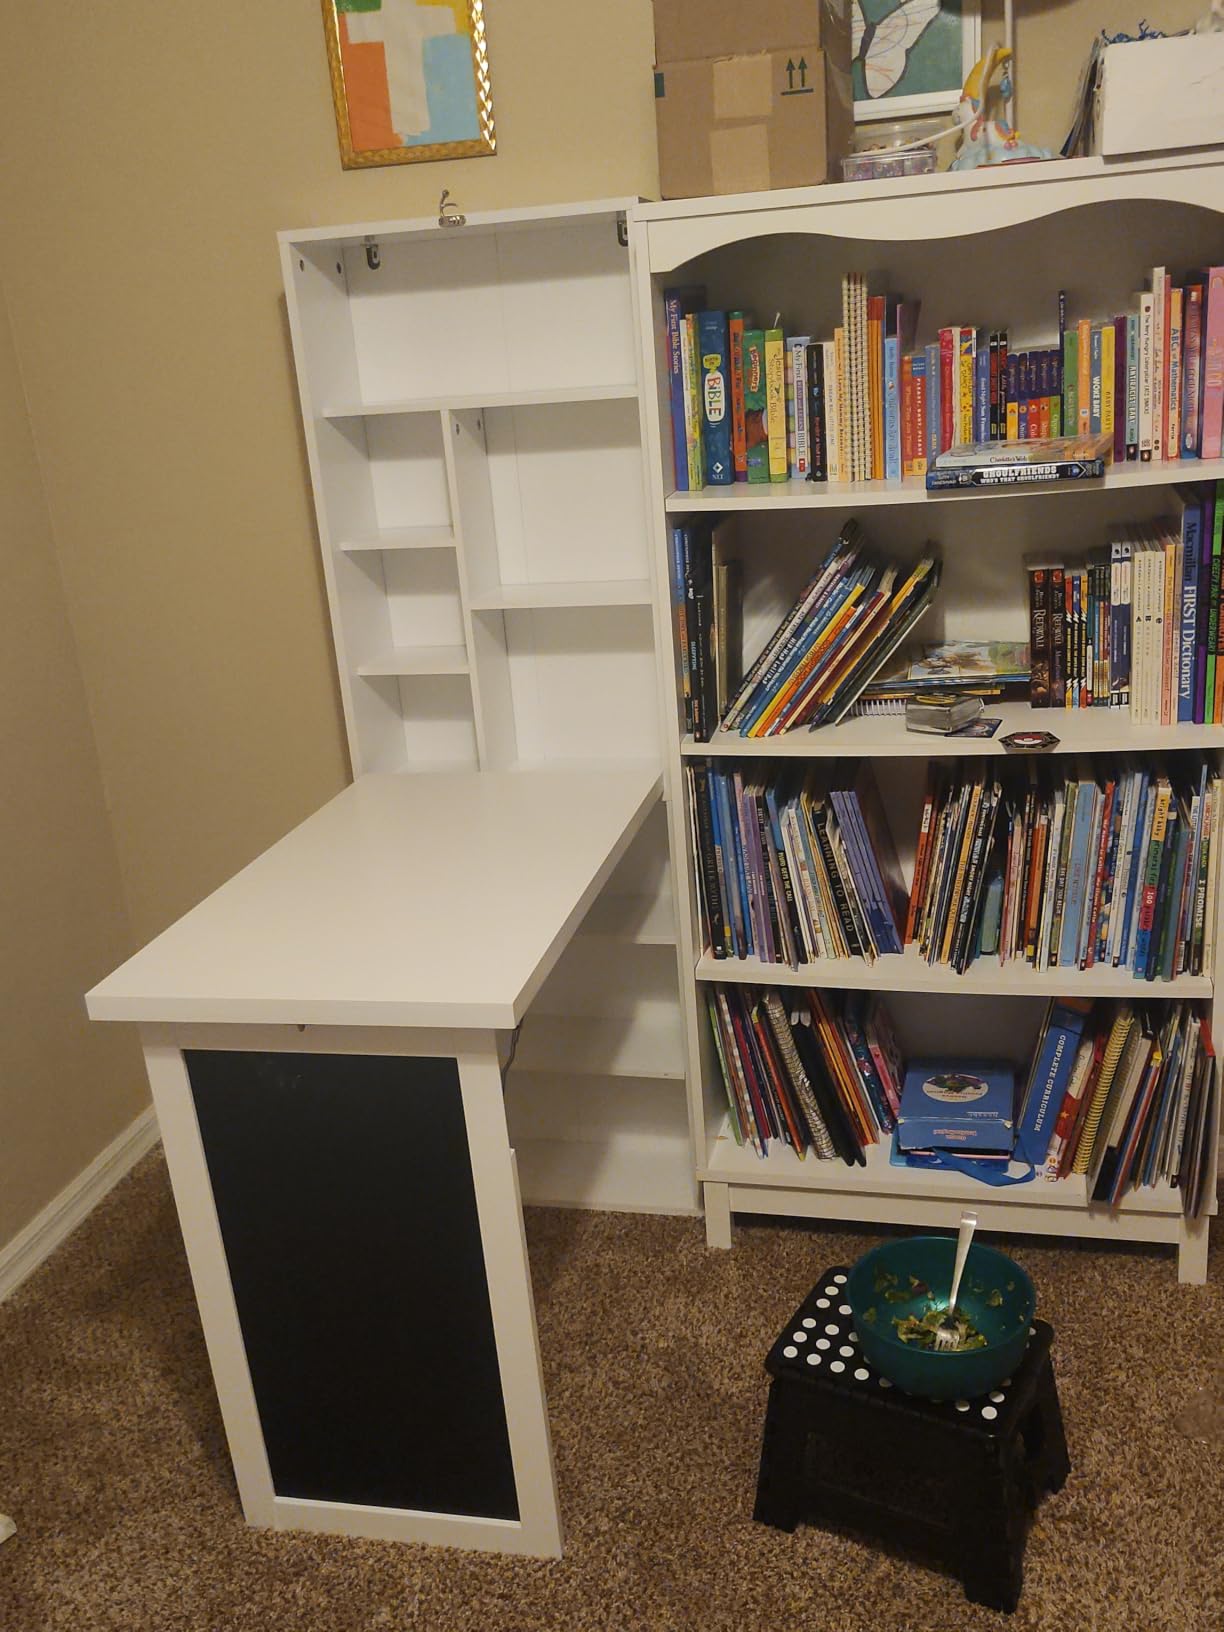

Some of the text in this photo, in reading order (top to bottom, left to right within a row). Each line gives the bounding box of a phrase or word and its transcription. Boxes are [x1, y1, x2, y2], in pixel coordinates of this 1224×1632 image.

[669, 300, 678, 312] My
[672, 331, 680, 350] Bible
[794, 350, 802, 364] My
[673, 351, 682, 375] Stories
[708, 376, 722, 416] BIBLE
[1129, 366, 1137, 404] ANTIRACIST
[1170, 361, 1179, 412] Mathematics
[1129, 406, 1137, 424] BABY
[983, 466, 1057, 478] GHOULFRIENDS
[1032, 608, 1046, 648] REDWALL
[1052, 613, 1064, 646] REDWALL
[1178, 522, 1196, 700] Macmillan FIRST Dictionary
[1208, 608, 1218, 652] UNDERWEAR!
[785, 890, 793, 902] CALL
[816, 822, 854, 932] LEARNING TO READ
[1195, 886, 1204, 928] PROMISE
[1034, 1034, 1066, 1132] COMPLETE CURRICULUM
